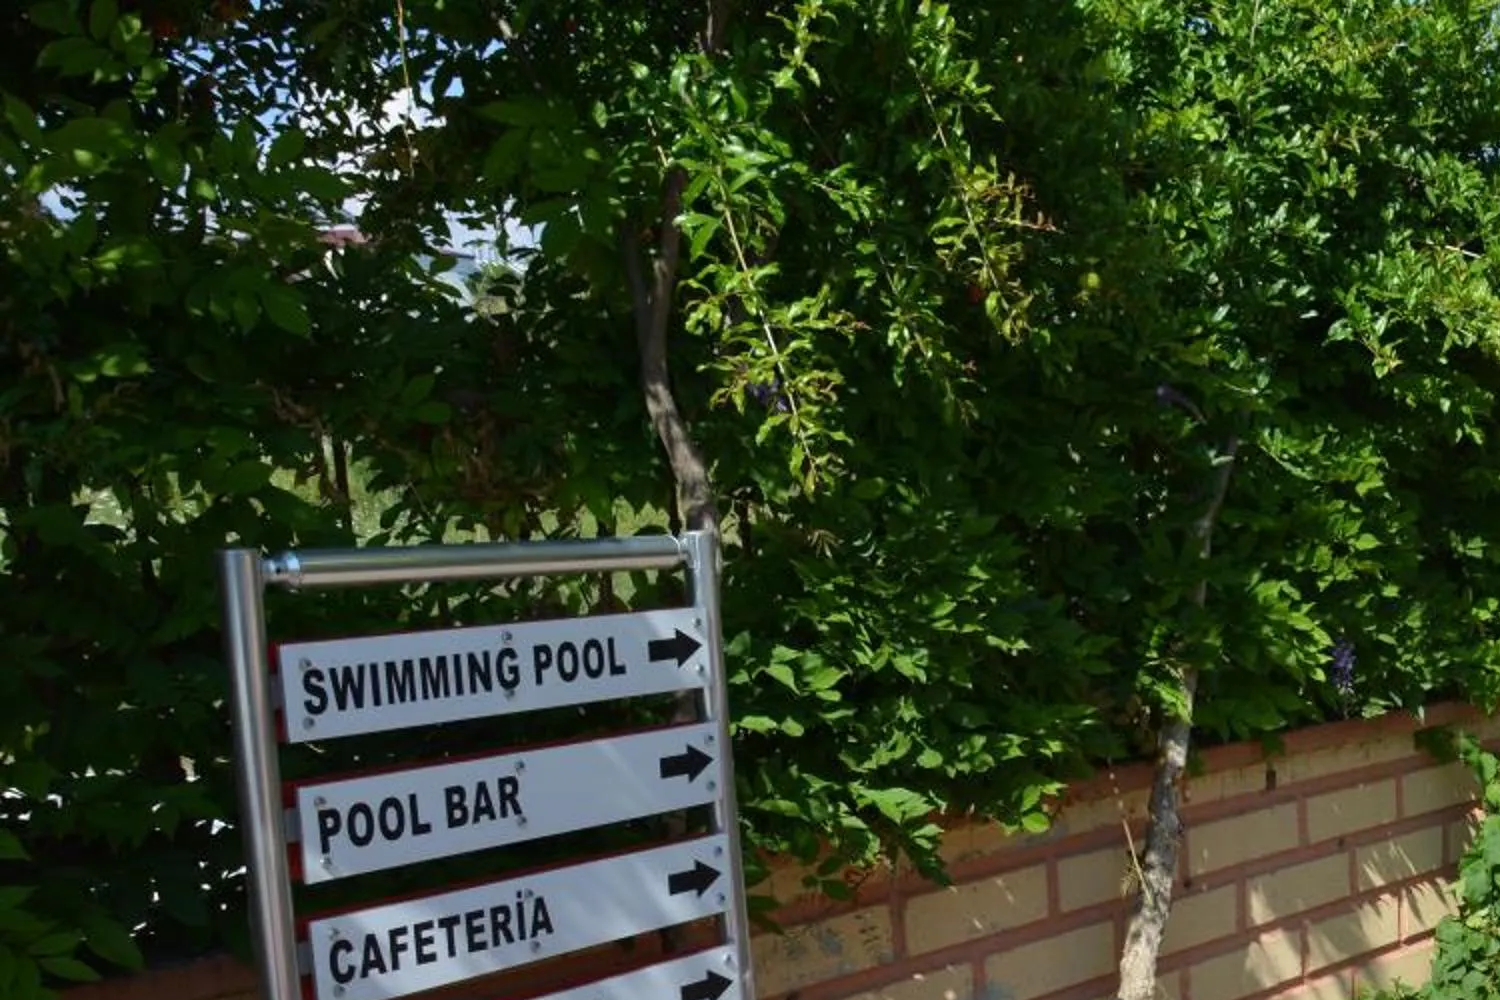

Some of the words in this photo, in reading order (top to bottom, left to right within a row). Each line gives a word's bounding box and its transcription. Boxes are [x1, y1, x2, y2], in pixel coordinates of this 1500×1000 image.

[302, 646, 521, 716] SWIMMING
[533, 636, 627, 684] POOL
[317, 793, 432, 854] POOL
[444, 775, 524, 829] BAR
